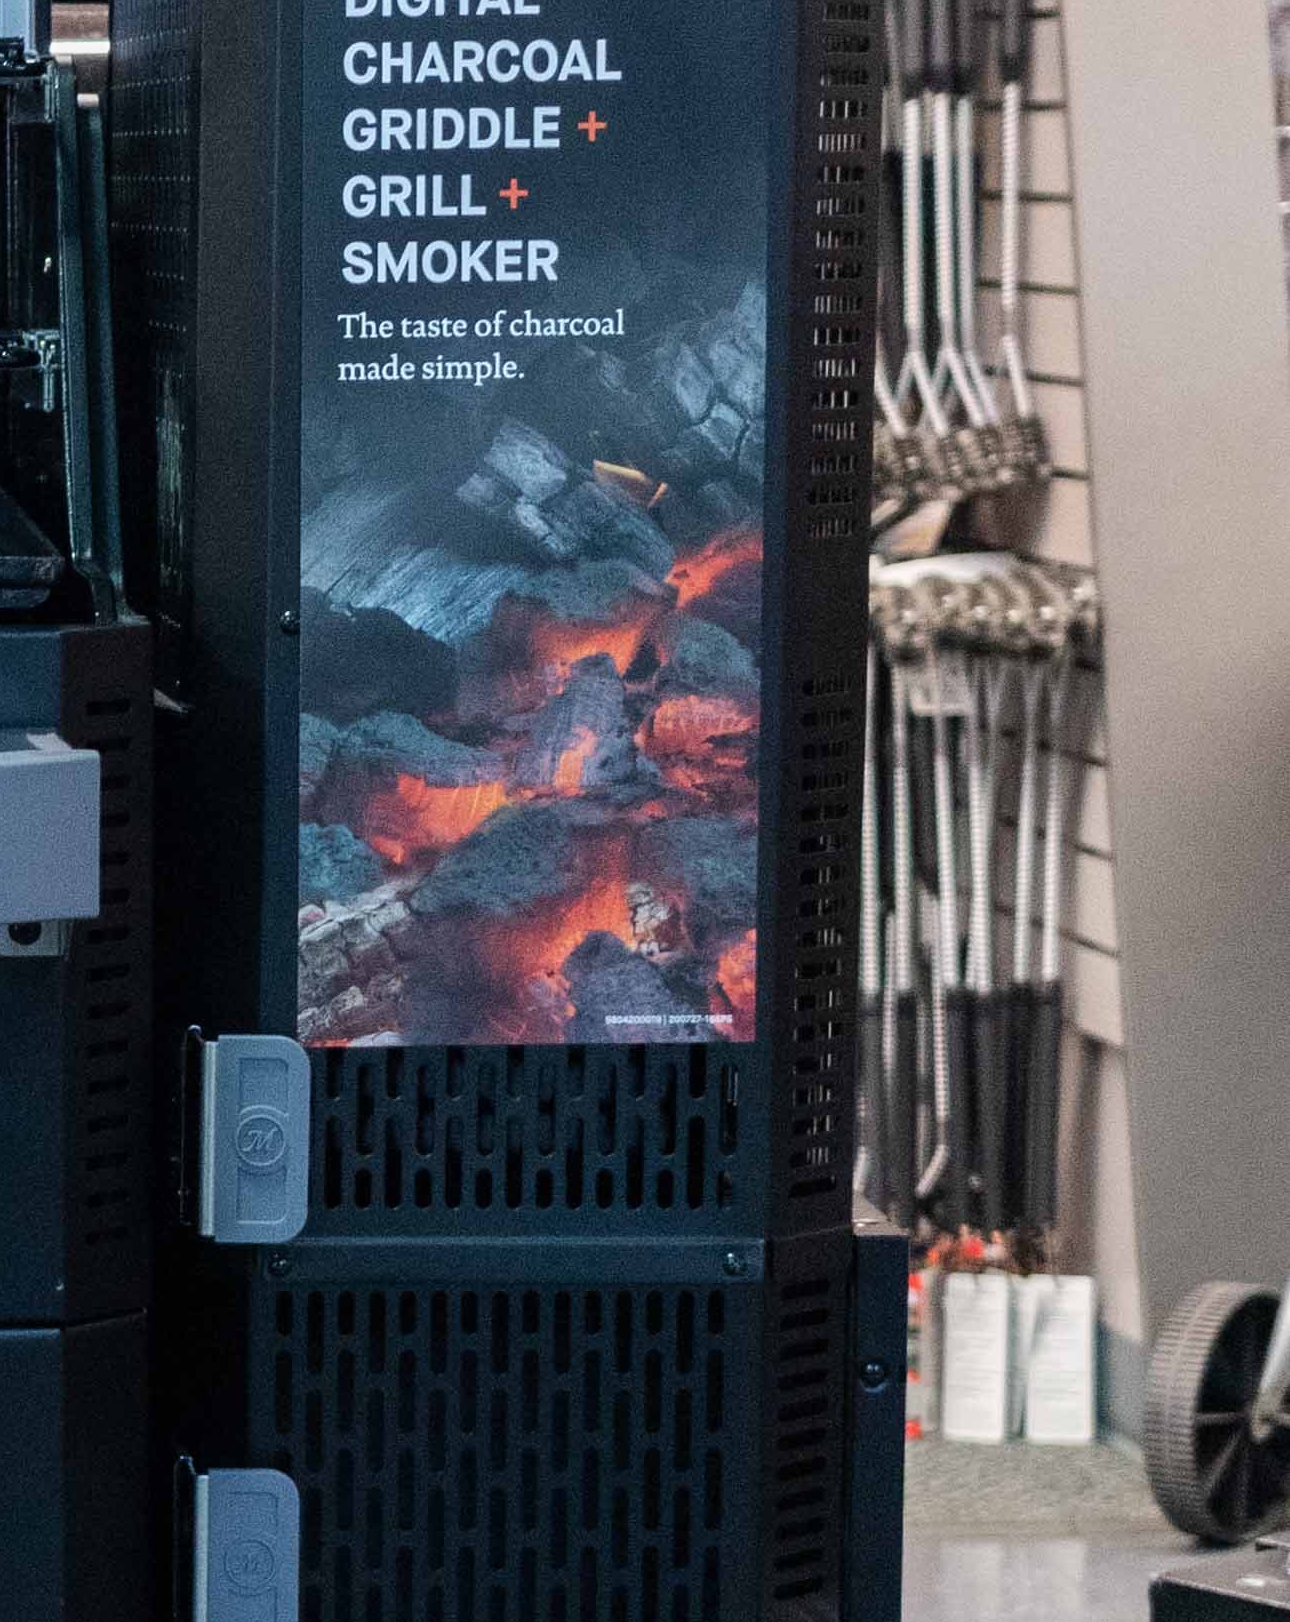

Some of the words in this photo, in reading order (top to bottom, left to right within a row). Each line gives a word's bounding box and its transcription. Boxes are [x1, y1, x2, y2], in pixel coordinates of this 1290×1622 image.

[342, 39, 623, 85] CHARCOAL
[342, 106, 561, 152] GRIDDLE
[341, 173, 487, 218] GRILL
[341, 239, 559, 285] SMOKER
[337, 311, 394, 339] The
[401, 317, 467, 338] taste
[474, 309, 507, 337] of
[510, 308, 625, 336] charcoal
[337, 353, 415, 380] made
[422, 352, 525, 387] simple.
